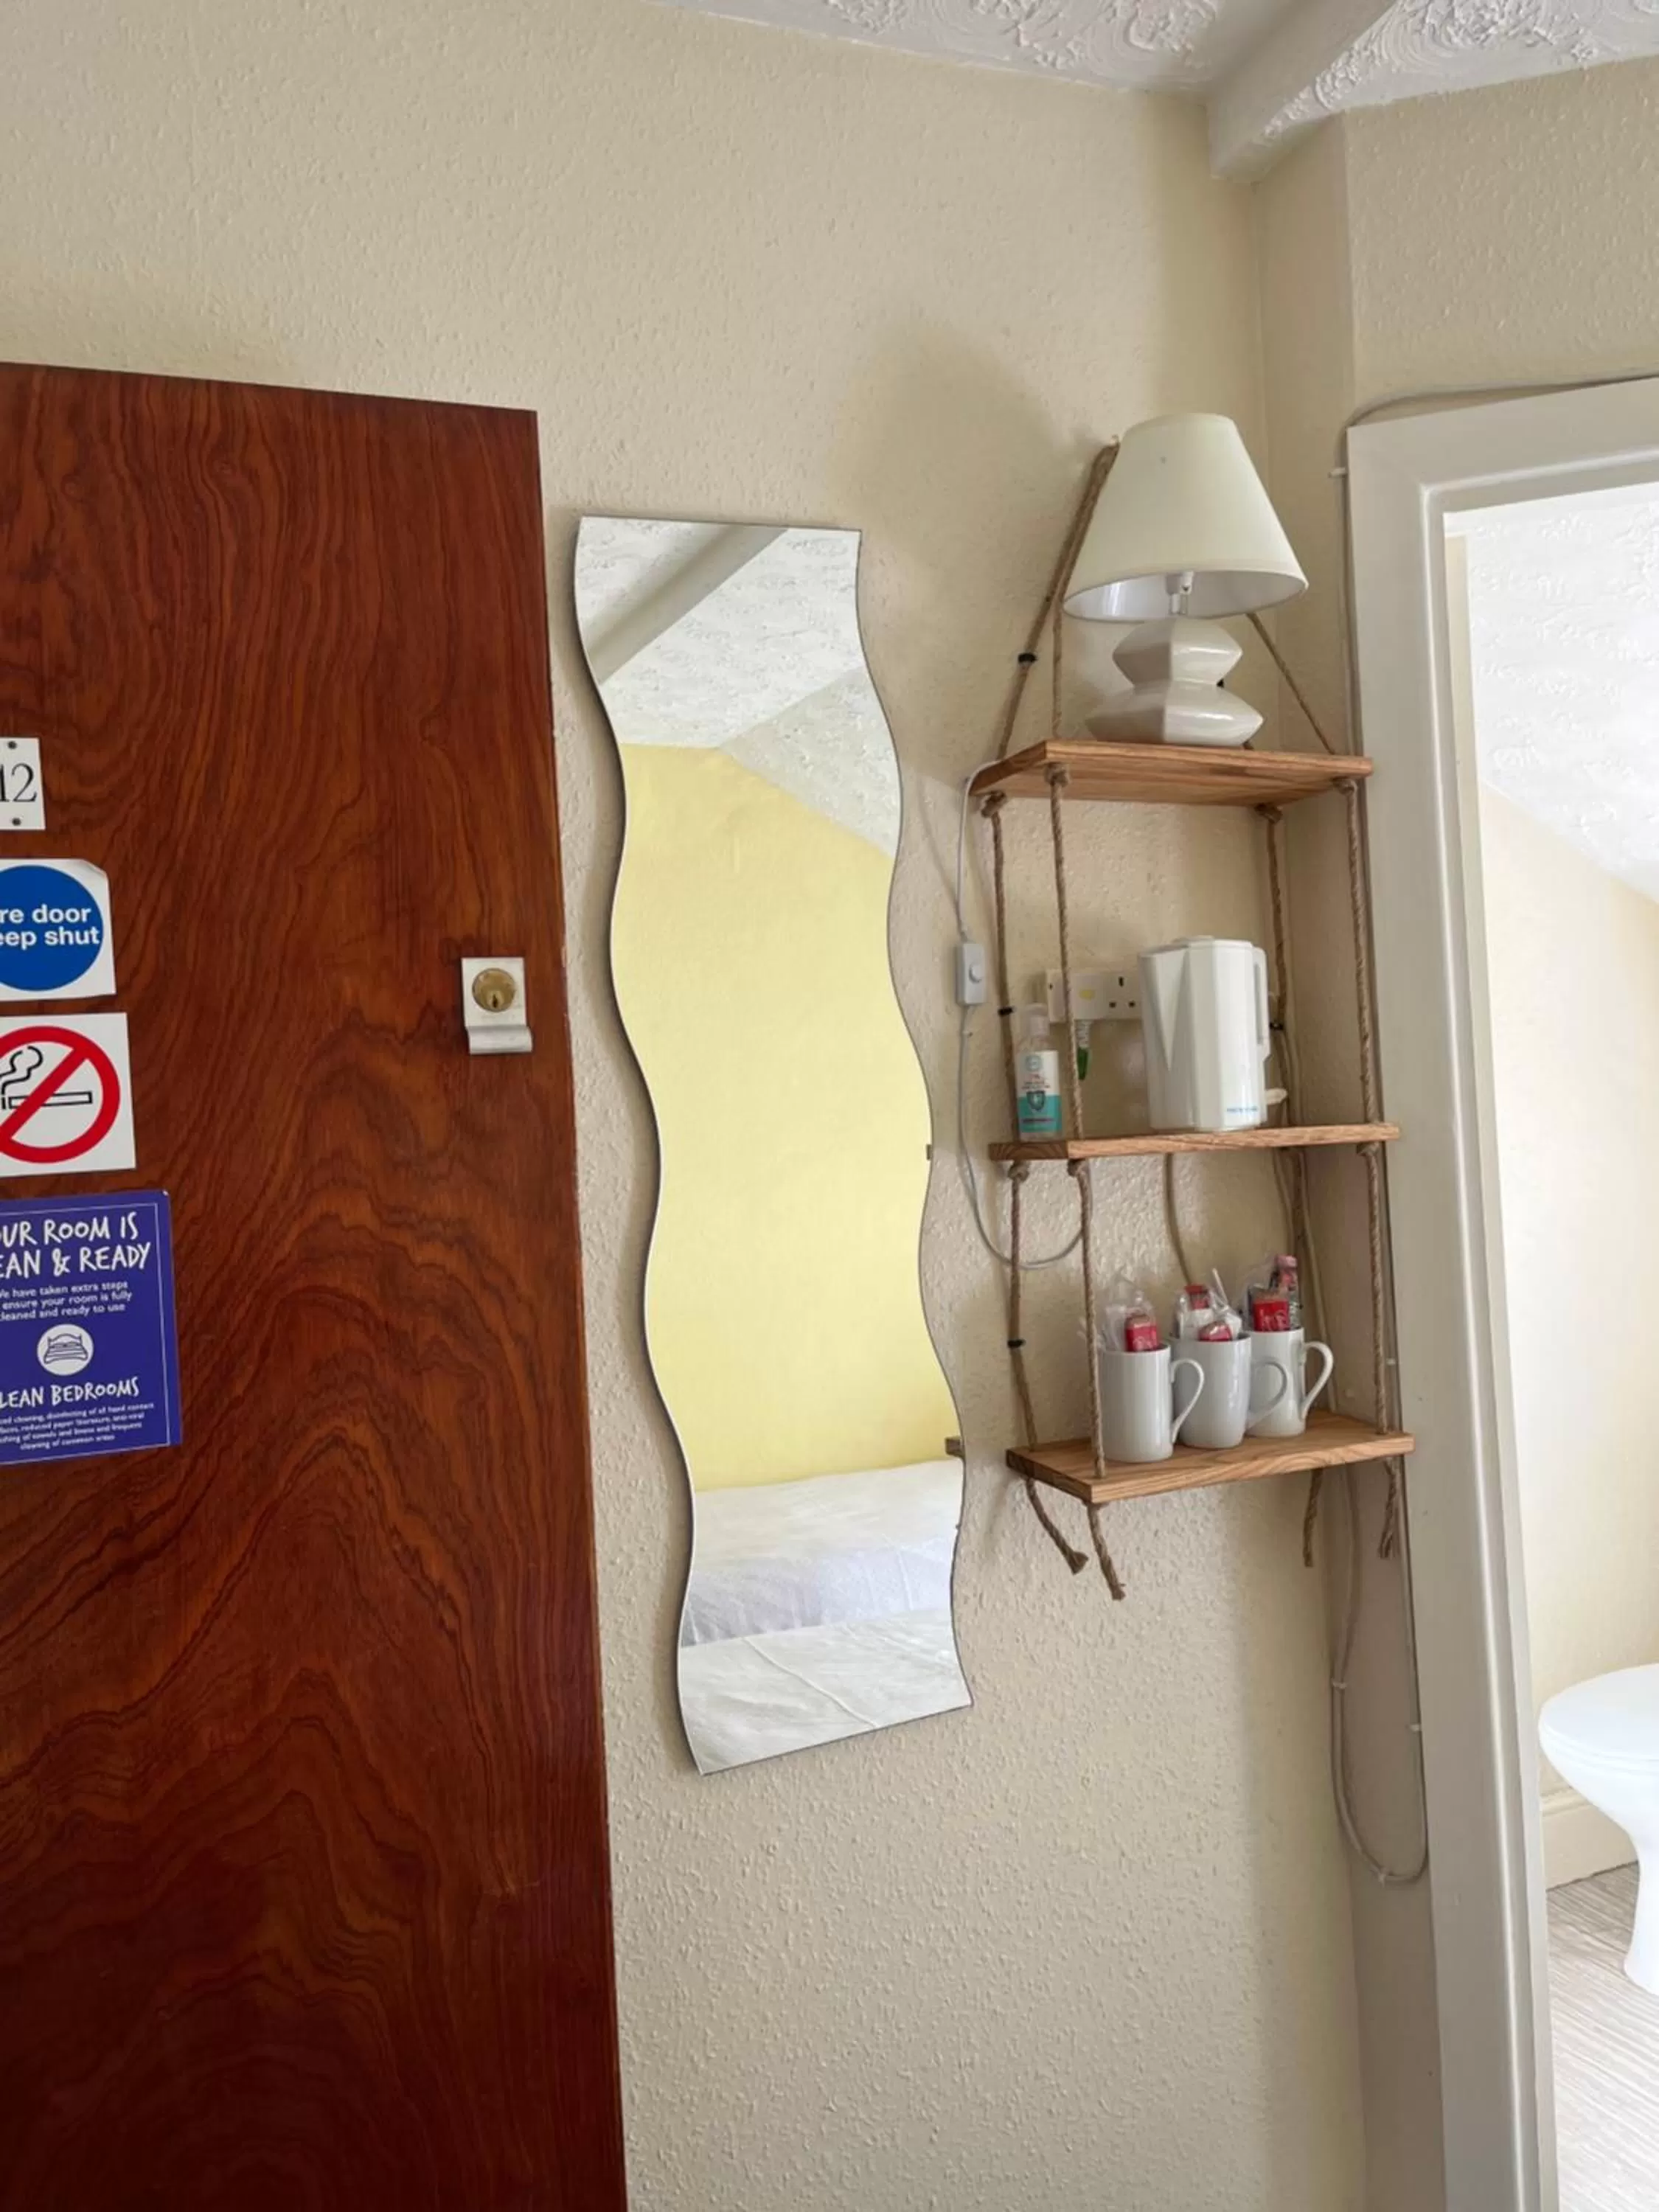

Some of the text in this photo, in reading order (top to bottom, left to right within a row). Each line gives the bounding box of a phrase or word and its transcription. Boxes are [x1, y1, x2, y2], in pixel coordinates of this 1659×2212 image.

[0, 762, 38, 802] 12
[32, 903, 91, 924] door
[44, 926, 100, 946] shut
[0, 1211, 139, 1248] UR ROOM IS
[52, 1248, 72, 1277] &
[79, 1242, 150, 1273] READY
[2, 1290, 133, 1310] ensure your room is fully
[12, 1287, 37, 1298] have
[39, 1285, 69, 1296] taken
[71, 1283, 99, 1293] extra
[101, 1281, 128, 1291] steps
[39, 1306, 58, 1318] and
[61, 1304, 91, 1318] ready
[93, 1304, 105, 1314] to
[107, 1303, 126, 1313] use
[50, 1377, 139, 1407] BEDROOMS
